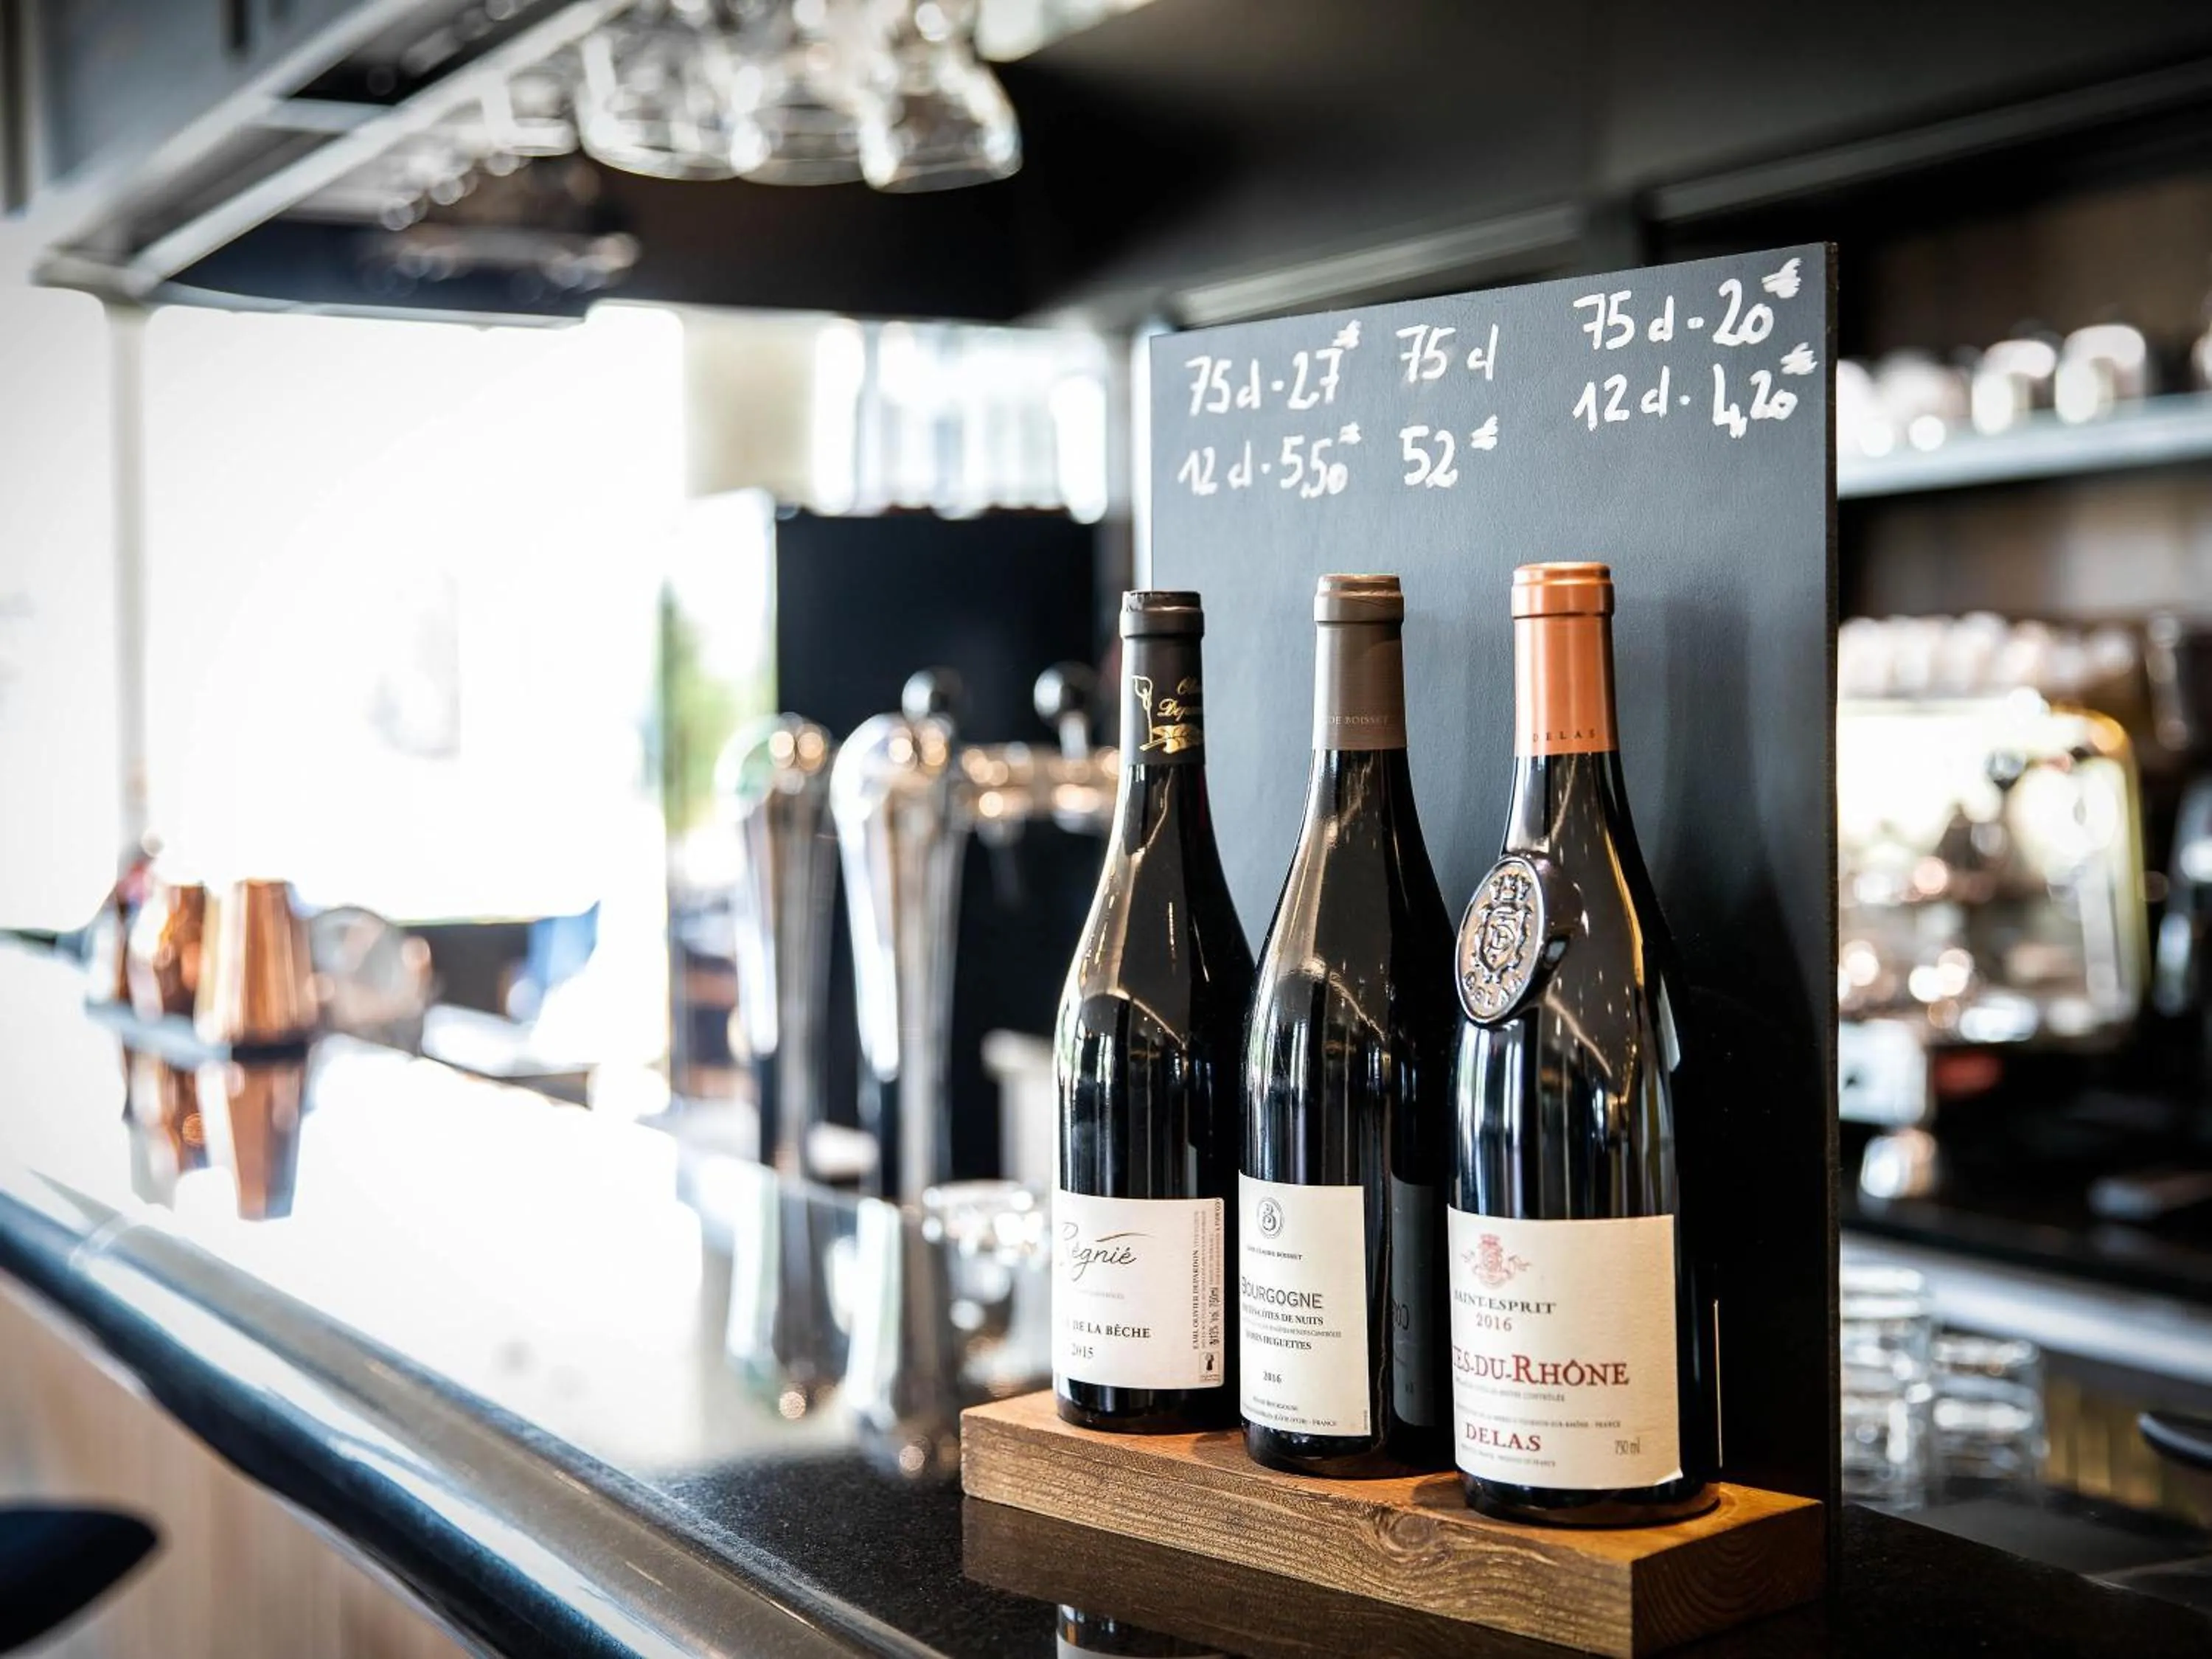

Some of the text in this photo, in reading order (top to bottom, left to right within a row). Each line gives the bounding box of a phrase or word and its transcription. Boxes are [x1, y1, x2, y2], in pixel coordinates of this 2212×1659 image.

[1573, 290, 1635, 349] 75
[1396, 324, 1456, 383] 75
[1572, 374, 1630, 431] 12
[1178, 446, 1218, 496] 12
[1533, 728, 1596, 742] DELAS
[1088, 1323, 1102, 1335] LA
[1105, 1324, 1151, 1338] BÊCHE
[1295, 1315, 1324, 1326] NUITS
[1476, 1312, 1513, 1332] 2016
[1071, 1343, 1093, 1360] 2015
[1465, 1422, 1542, 1452] DELAS
